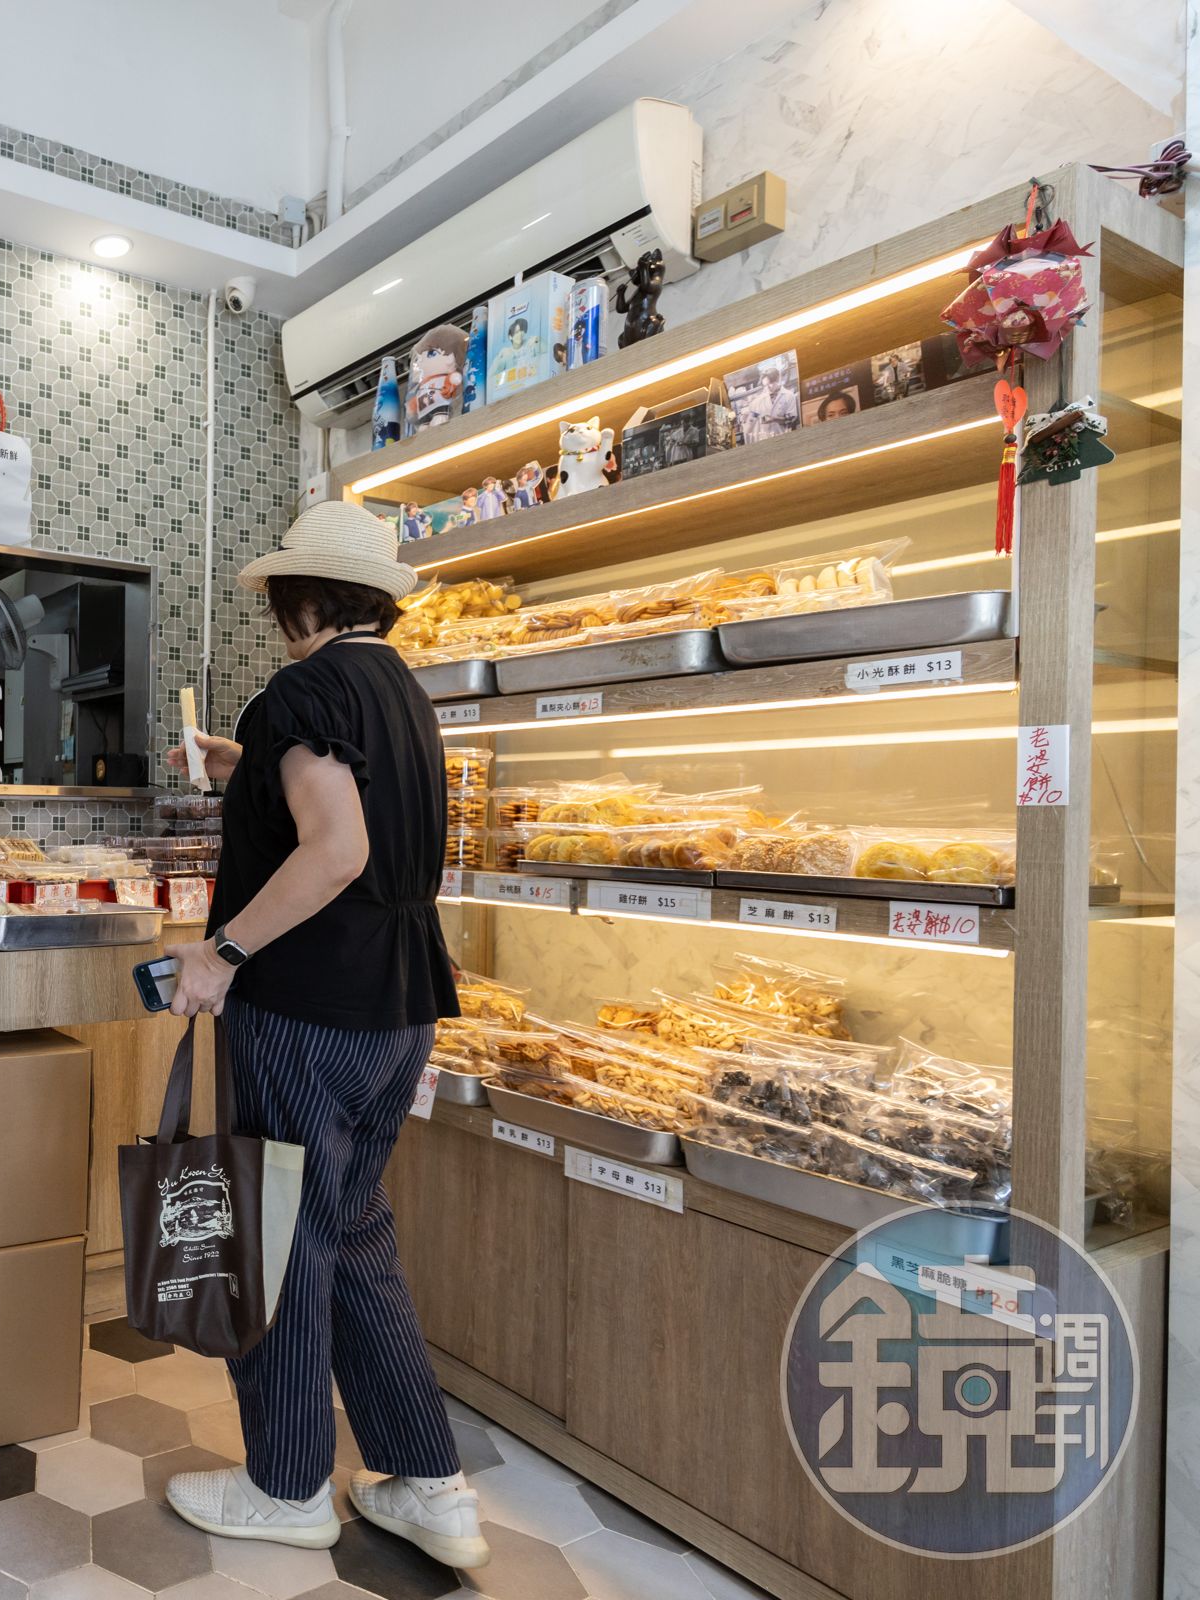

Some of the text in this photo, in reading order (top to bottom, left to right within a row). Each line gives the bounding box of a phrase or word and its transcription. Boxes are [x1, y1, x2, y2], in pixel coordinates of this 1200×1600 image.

[857, 659, 953, 680] 小光酥餅 $13
[463, 708, 477, 717] $13
[657, 897, 676, 908] $15
[747, 905, 830, 924] 芝麻餅 $13
[536, 1137, 551, 1149] $13
[598, 1166, 662, 1194] 字母餅 $13
[891, 1254, 968, 1292] 黑芝麻脆糖
